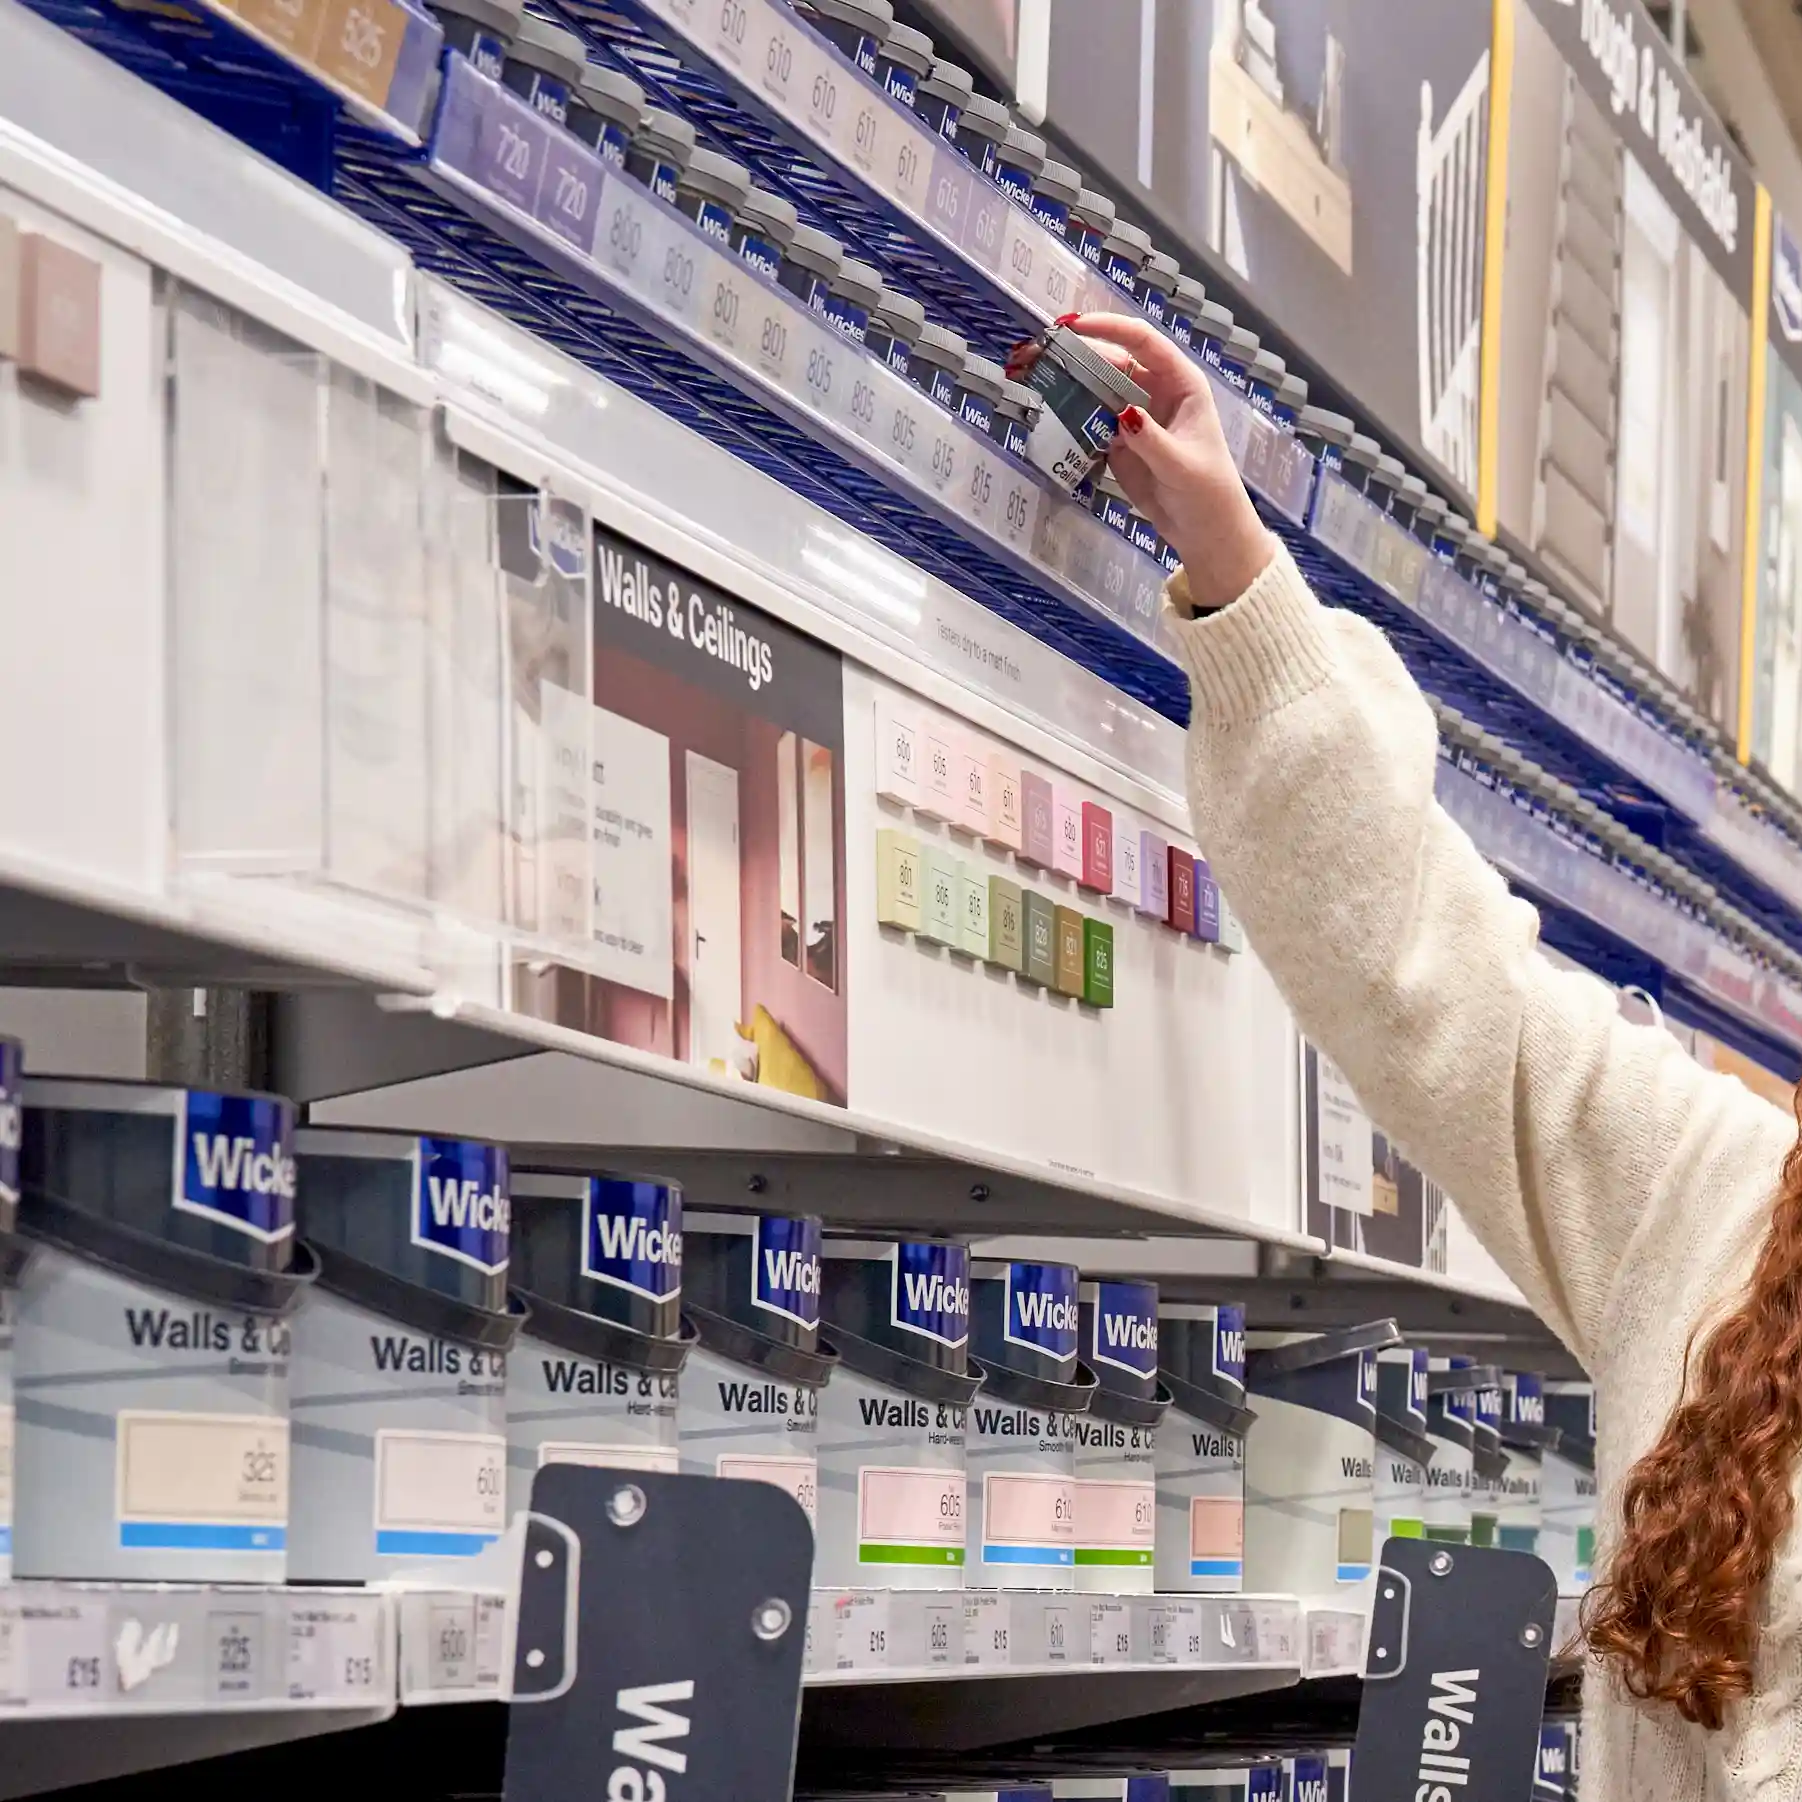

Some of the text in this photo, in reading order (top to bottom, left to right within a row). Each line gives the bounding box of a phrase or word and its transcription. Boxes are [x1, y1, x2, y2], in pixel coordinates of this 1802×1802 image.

[767, 37, 793, 83] 610
[812, 76, 836, 119] 610
[971, 464, 991, 503] 815
[1006, 490, 1026, 529] 815
[598, 544, 773, 691] Walls & Ceilings
[896, 738, 911, 763] 600
[933, 753, 947, 777] 605
[969, 771, 982, 794] 610
[1003, 788, 1014, 810] 611
[125, 1308, 230, 1351] Walls
[240, 1316, 260, 1356] &
[370, 1336, 462, 1374] Walls
[469, 1354, 484, 1376] &
[542, 1361, 629, 1396] Walls
[637, 1377, 652, 1401] &
[718, 1382, 788, 1414] Walls
[793, 1388, 805, 1416] &
[859, 1398, 930, 1429] Walls
[935, 1404, 948, 1430] &
[975, 1408, 1040, 1437] Walls
[1046, 1412, 1058, 1437] &
[1075, 1424, 1124, 1448] Walls
[1131, 1426, 1140, 1449] &
[1192, 1434, 1234, 1457] Walls
[869, 1631, 885, 1652] £15
[607, 1679, 695, 1802] Wa
[1415, 1668, 1480, 1802] Walls
